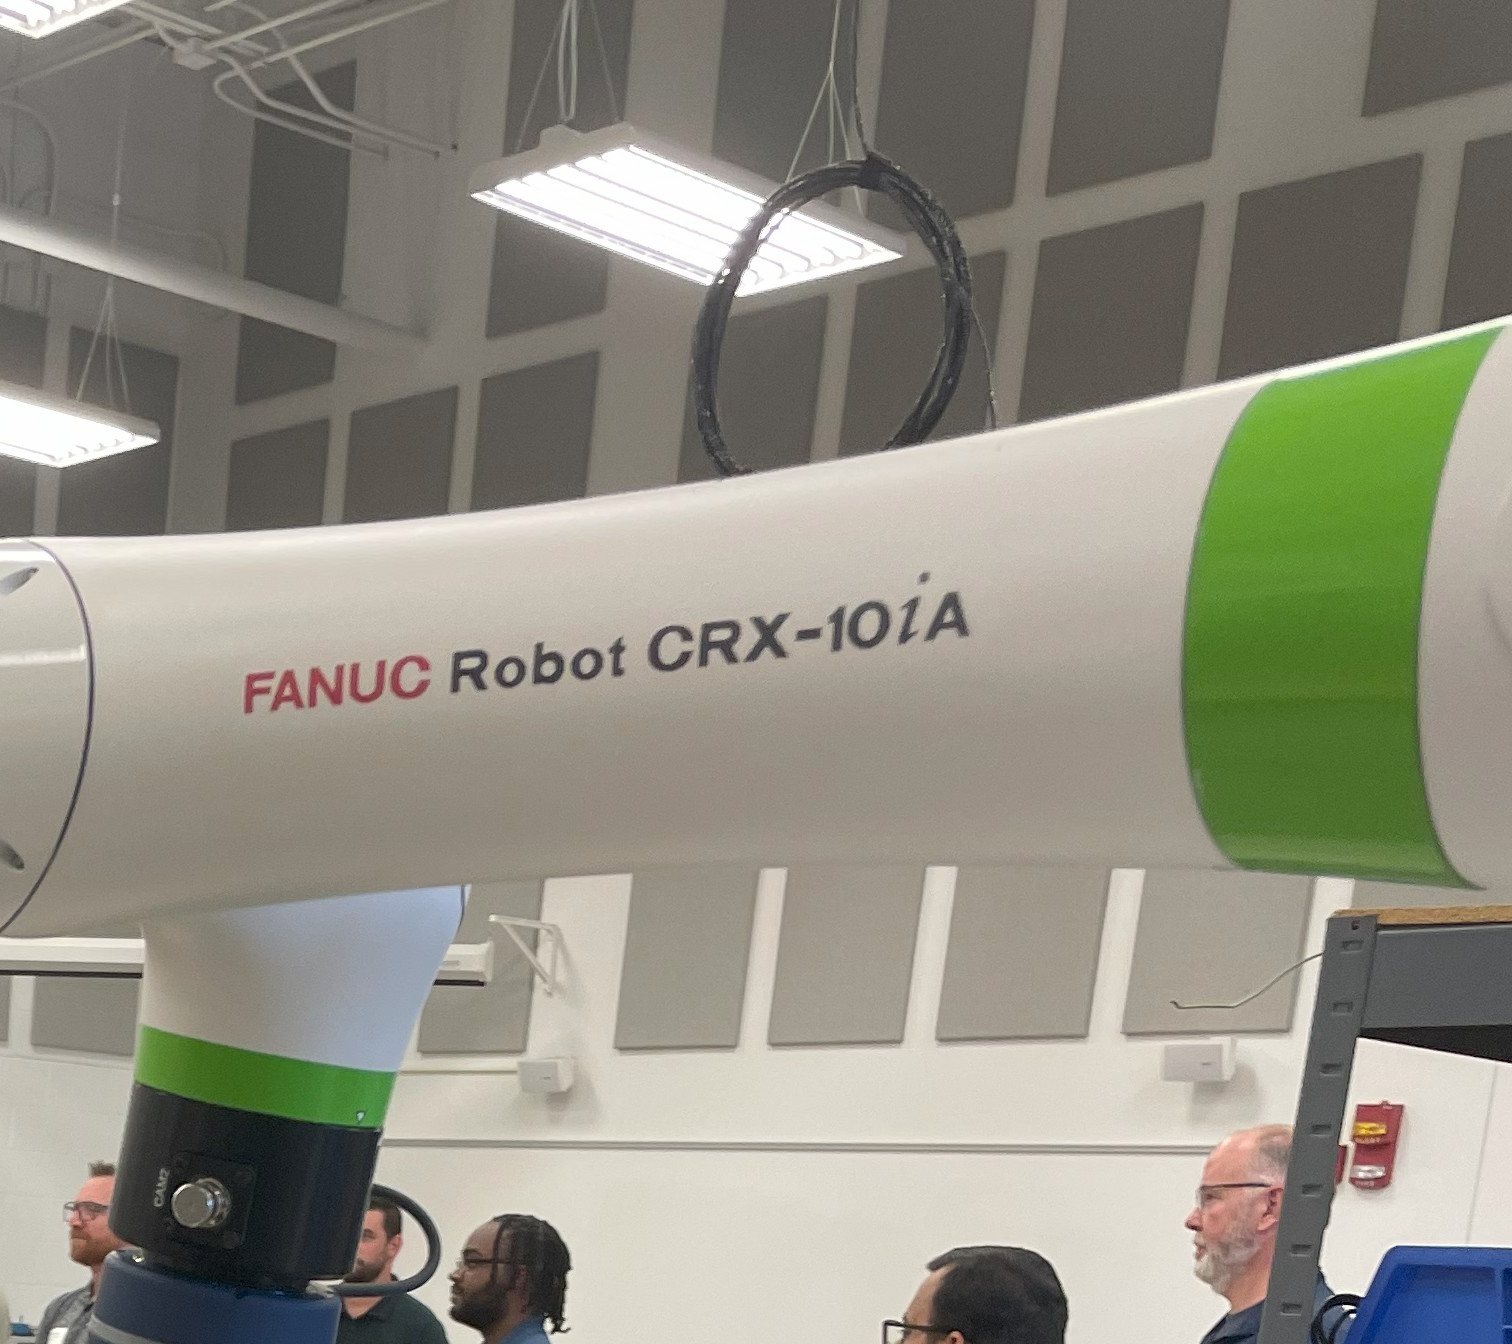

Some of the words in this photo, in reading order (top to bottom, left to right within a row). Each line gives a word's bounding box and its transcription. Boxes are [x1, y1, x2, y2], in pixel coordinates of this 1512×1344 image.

[243, 655, 431, 713] FANUC
[450, 633, 626, 692] Robot
[647, 572, 970, 672] CRX-10iA
[153, 1167, 170, 1208] CAM2
